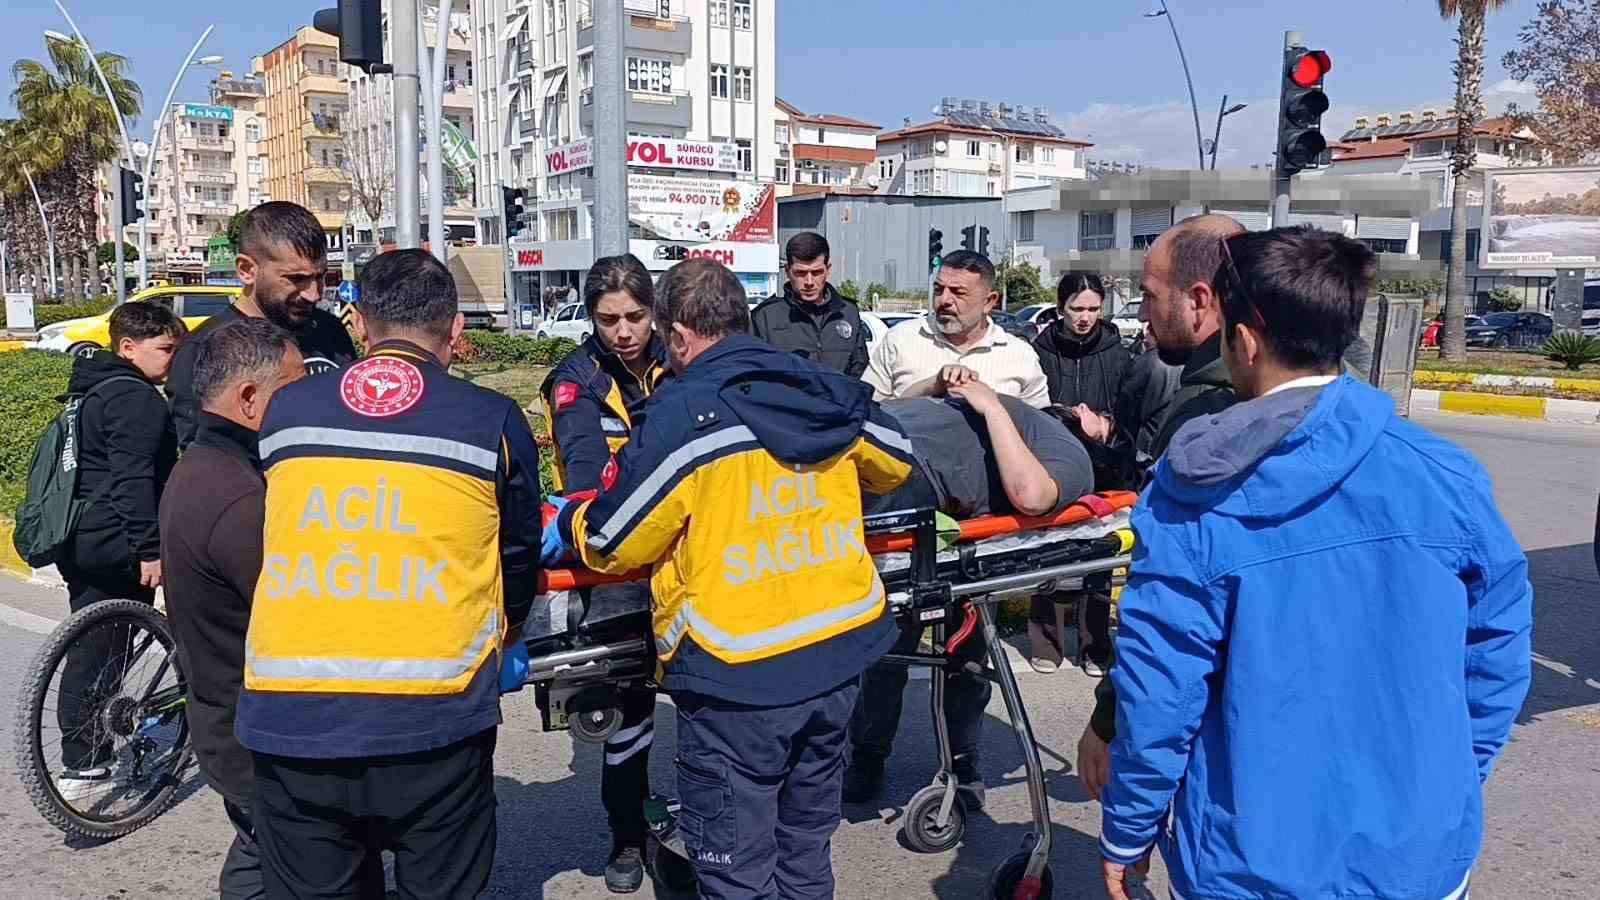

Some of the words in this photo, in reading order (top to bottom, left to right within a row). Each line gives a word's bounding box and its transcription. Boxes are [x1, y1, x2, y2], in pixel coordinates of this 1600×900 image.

[626, 142, 673, 164] YOL
[676, 143, 714, 154] SÜRÜCÜ
[545, 151, 568, 173] YOL
[676, 155, 714, 167] KURSU
[669, 192, 707, 205] 94.900
[709, 195, 721, 206] TL
[518, 250, 543, 265] BOSCH
[747, 463, 827, 524] ACİL
[297, 476, 418, 535] ACİL
[723, 517, 866, 585] SAĞLIK
[263, 543, 449, 603] SAĞLIK
